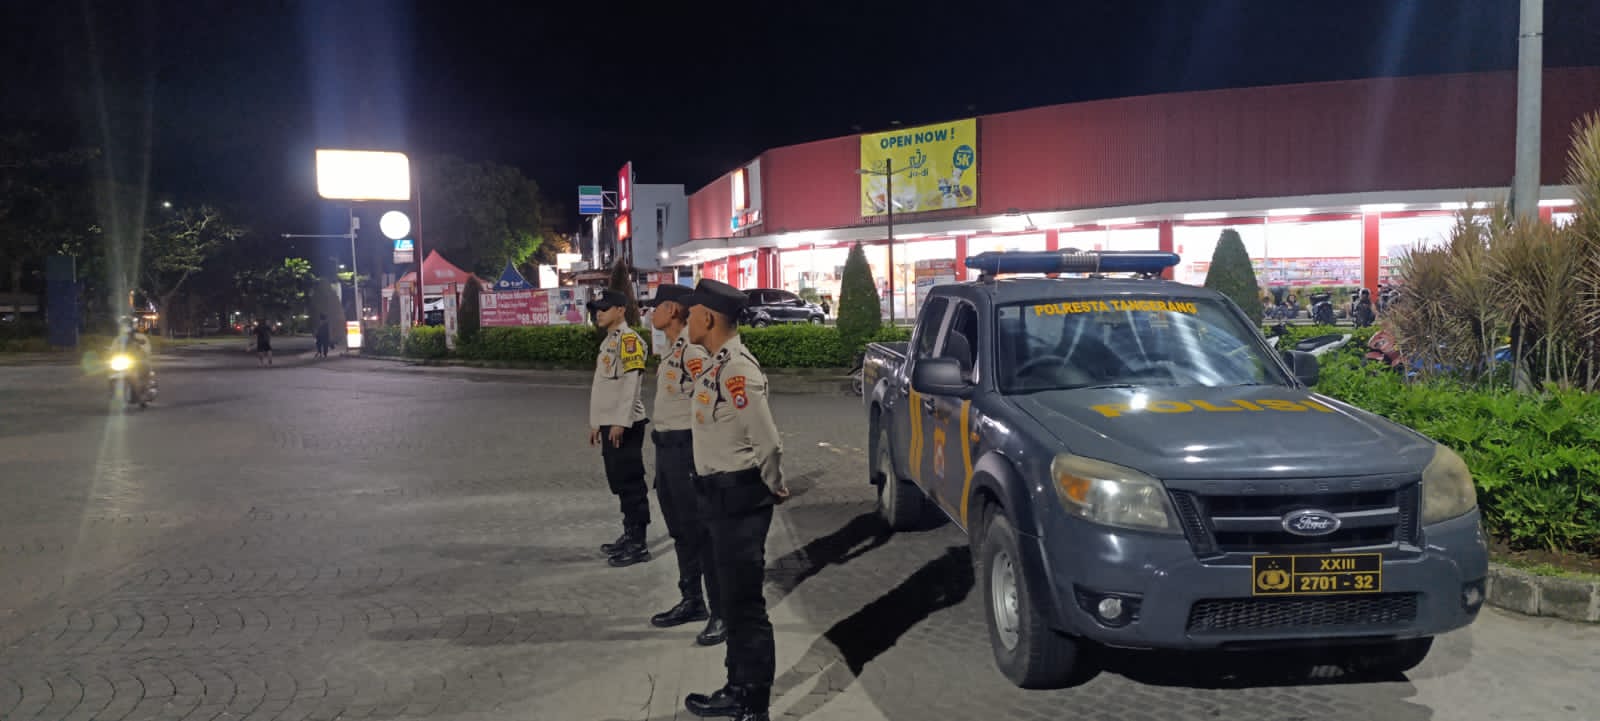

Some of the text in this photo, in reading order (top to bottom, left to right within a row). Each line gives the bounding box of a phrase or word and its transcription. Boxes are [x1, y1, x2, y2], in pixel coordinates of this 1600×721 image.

[880, 135, 911, 149] OPEN
[915, 128, 947, 144] NOW
[1035, 300, 1197, 316] POLRESTA TANGERANG
[1090, 399, 1334, 417] POLISI
[1293, 516, 1328, 530] Ford
[1320, 557, 1356, 570] XXIII
[1300, 575, 1337, 591] 2701
[1354, 574, 1374, 589] 32
